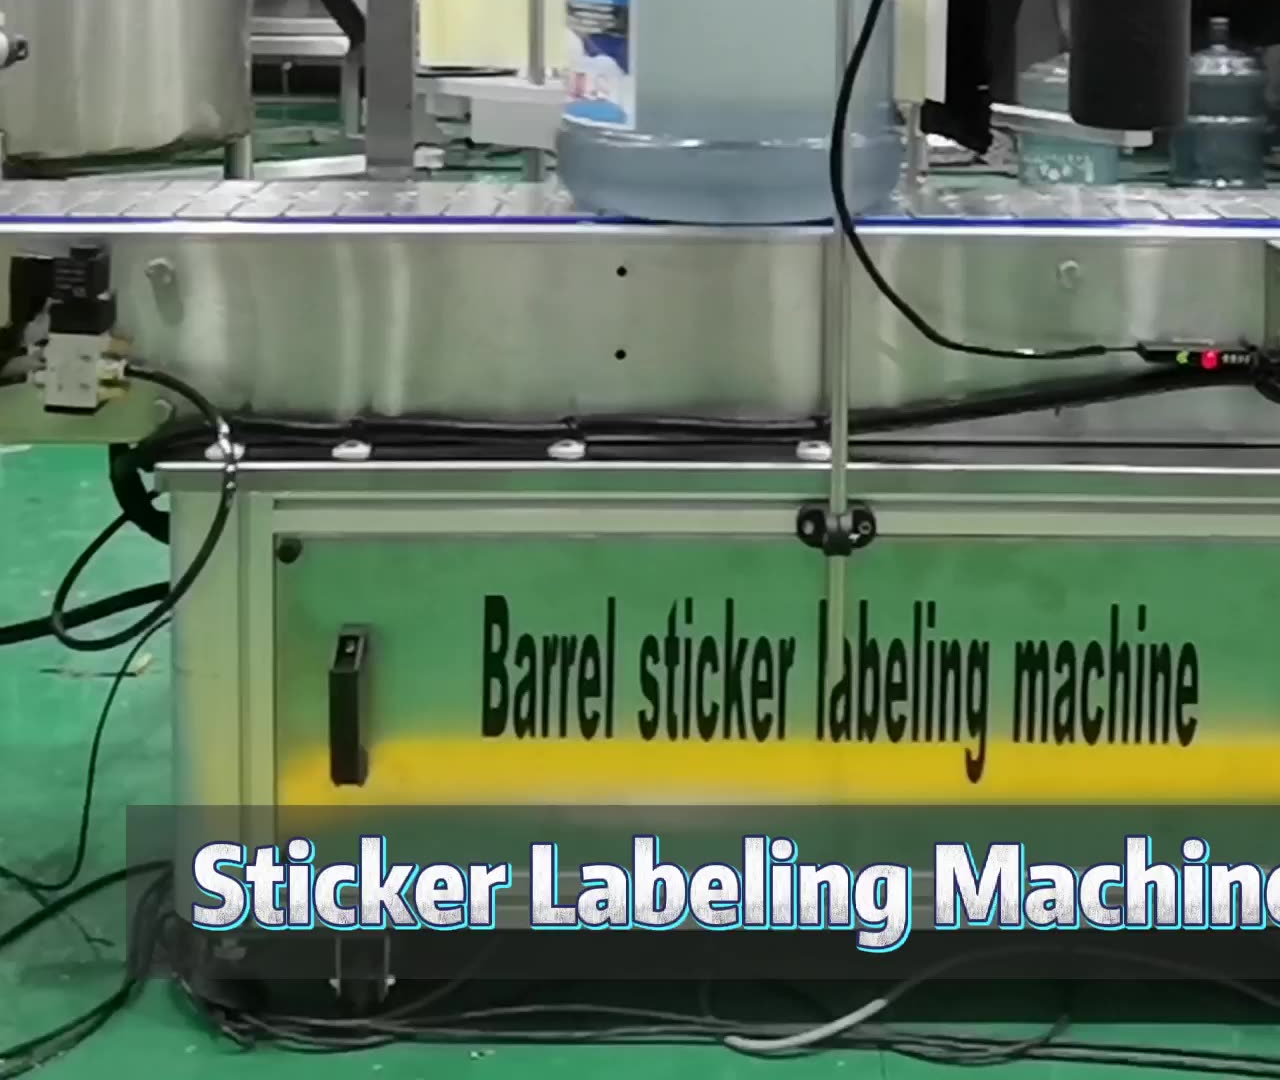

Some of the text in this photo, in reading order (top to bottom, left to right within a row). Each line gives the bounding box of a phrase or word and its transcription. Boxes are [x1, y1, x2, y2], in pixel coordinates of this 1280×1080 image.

[481, 594, 1200, 784] Barrel sticker labeling machine
